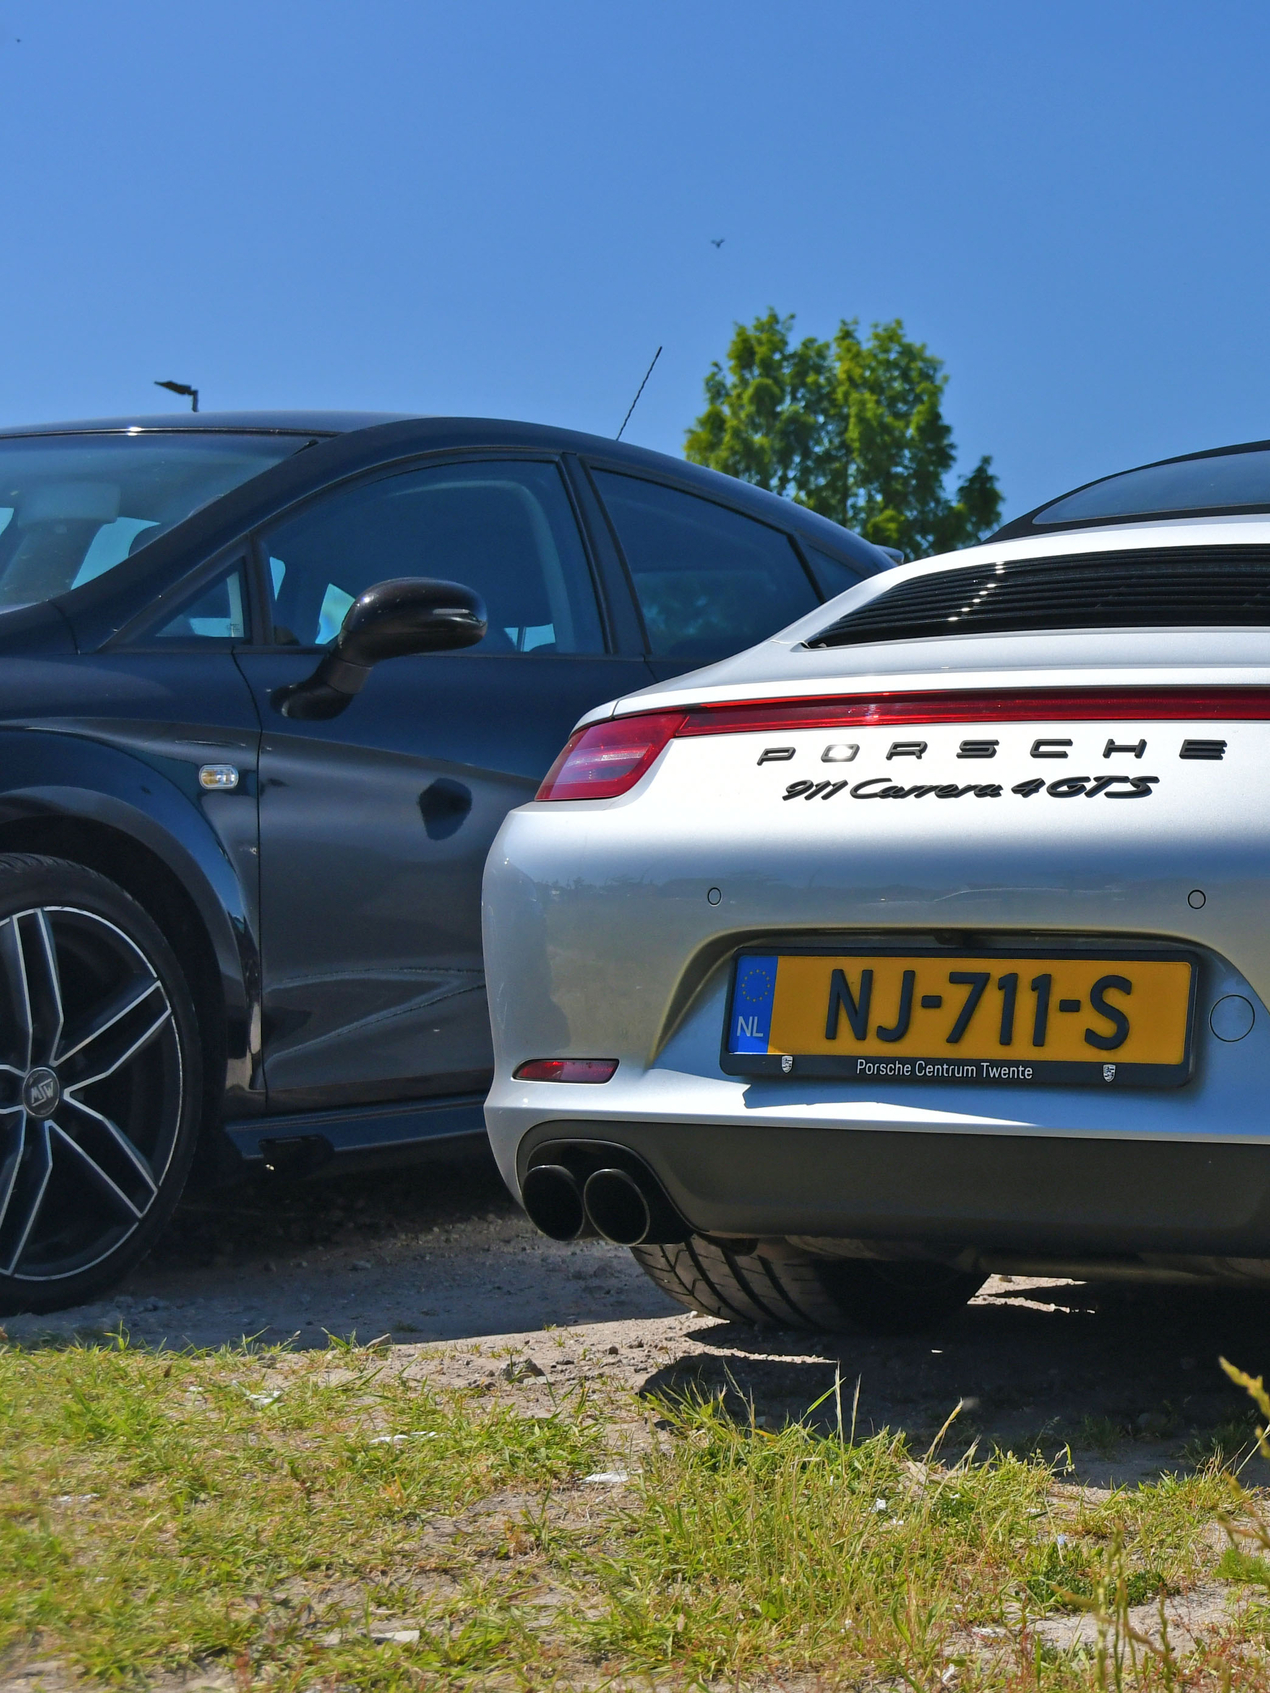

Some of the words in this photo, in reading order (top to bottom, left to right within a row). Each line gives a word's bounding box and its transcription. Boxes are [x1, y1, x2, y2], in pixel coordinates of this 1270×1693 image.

[757, 738, 1227, 766] PORSCHE
[782, 779, 848, 801] 911
[850, 778, 1003, 799] Carrera
[825, 968, 1132, 1050] NJ-711-S
[737, 1016, 764, 1038] NL
[857, 1059, 912, 1077] Porsche
[915, 1061, 976, 1078] Centrum
[981, 1062, 1033, 1079] Twente
[31, 1079, 54, 1107] MSW
